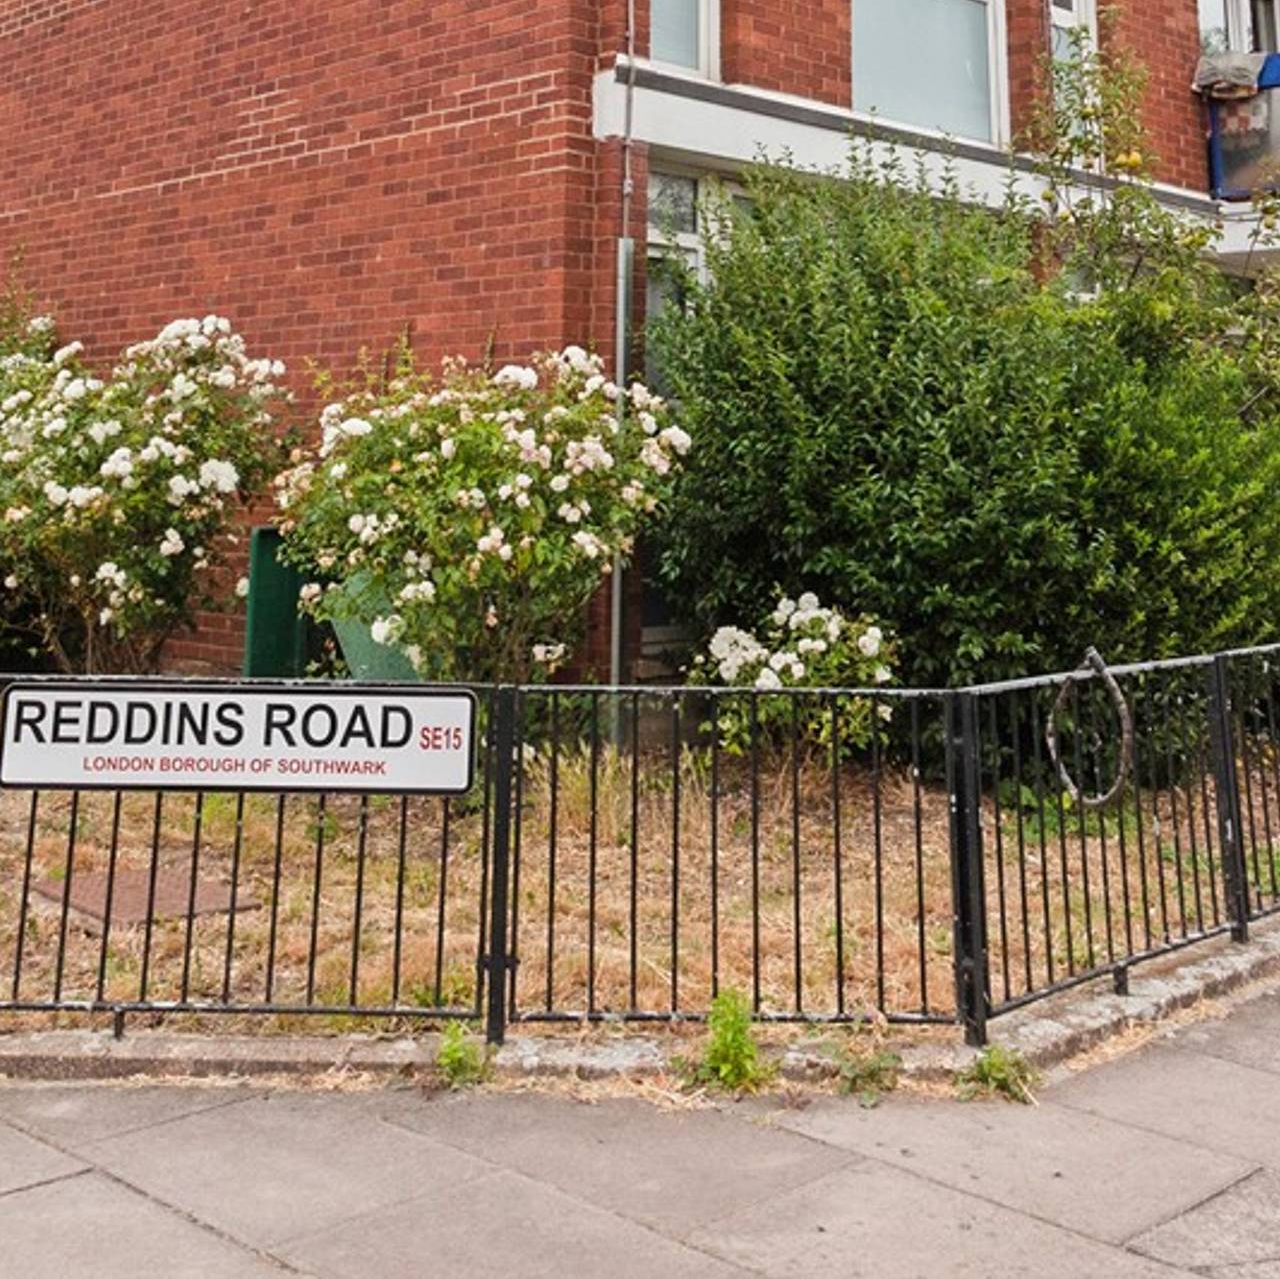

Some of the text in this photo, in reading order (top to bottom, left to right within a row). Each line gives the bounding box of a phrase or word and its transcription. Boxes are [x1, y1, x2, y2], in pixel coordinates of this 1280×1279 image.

[13, 700, 462, 751] REDDINS ROAD SE15
[83, 756, 386, 775] LONDON BOROUGH OF SOUTHWARK
